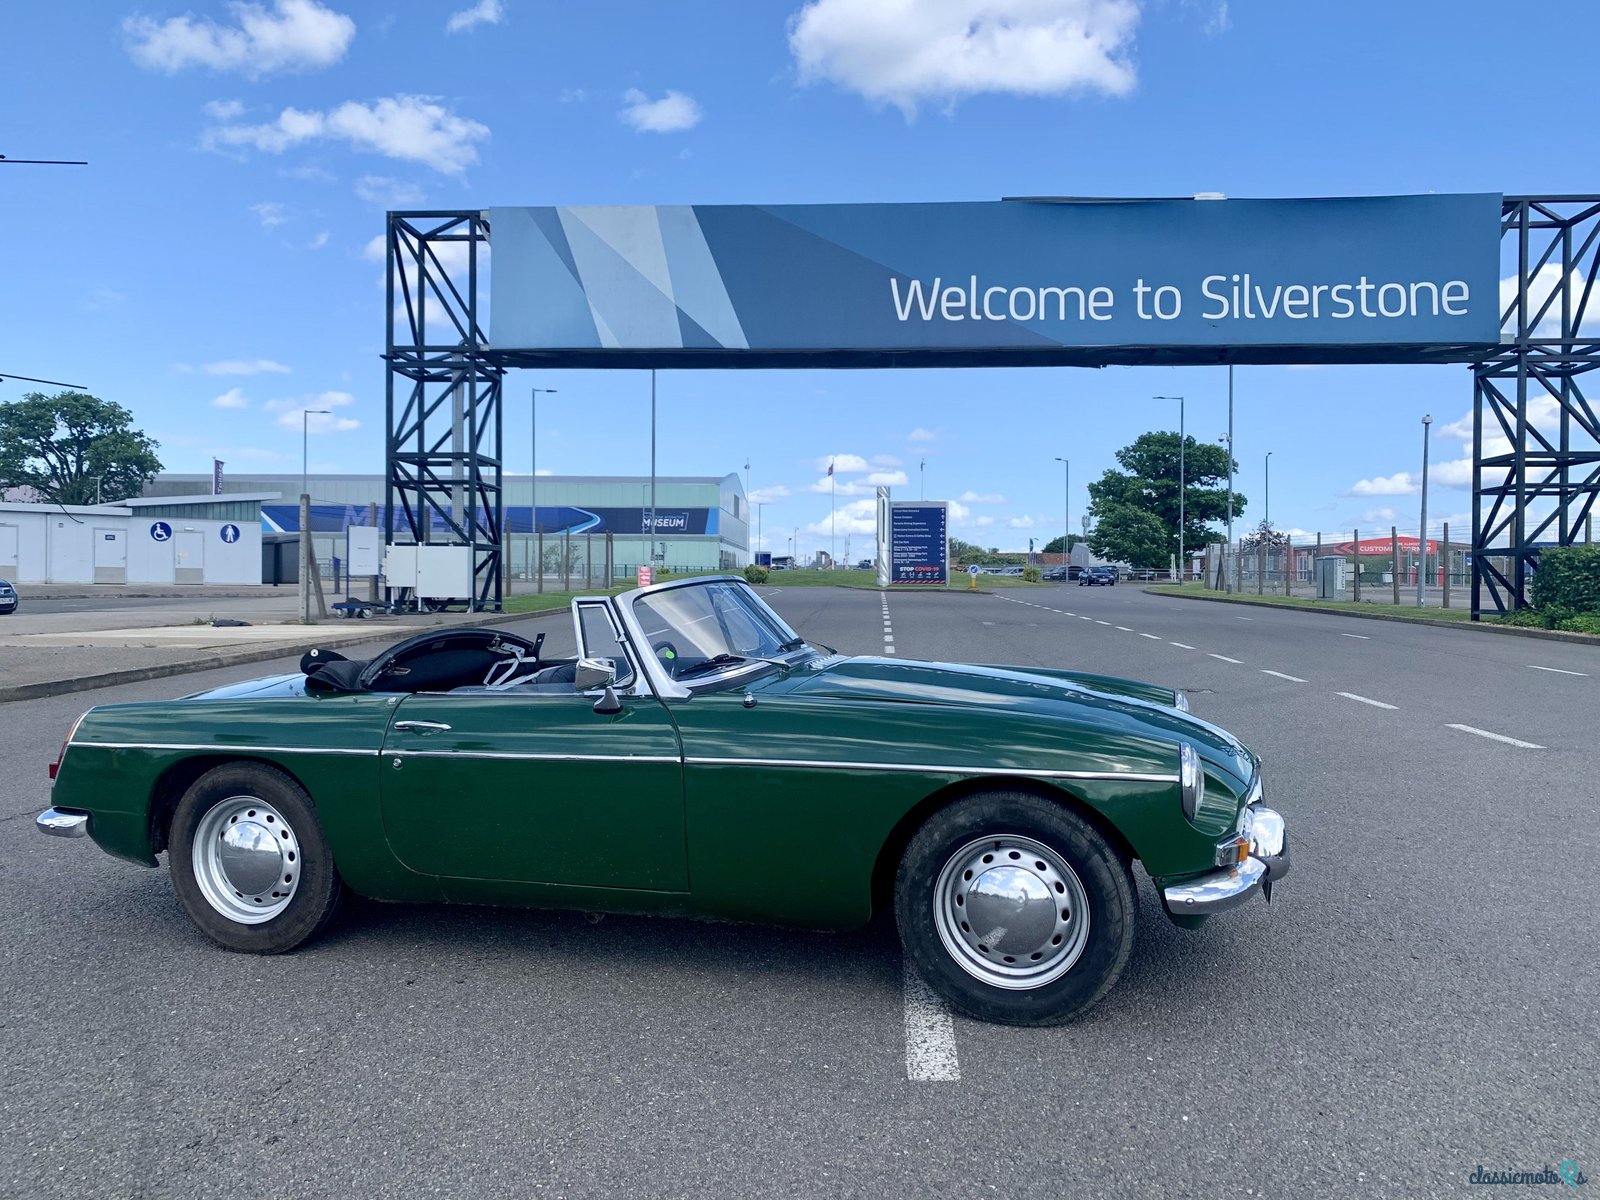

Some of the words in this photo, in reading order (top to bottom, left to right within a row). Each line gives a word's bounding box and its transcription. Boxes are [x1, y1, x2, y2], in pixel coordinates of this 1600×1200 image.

[890, 275, 1114, 321] Welcome
[1132, 279, 1182, 320] to
[1202, 273, 1469, 319] Silverstone
